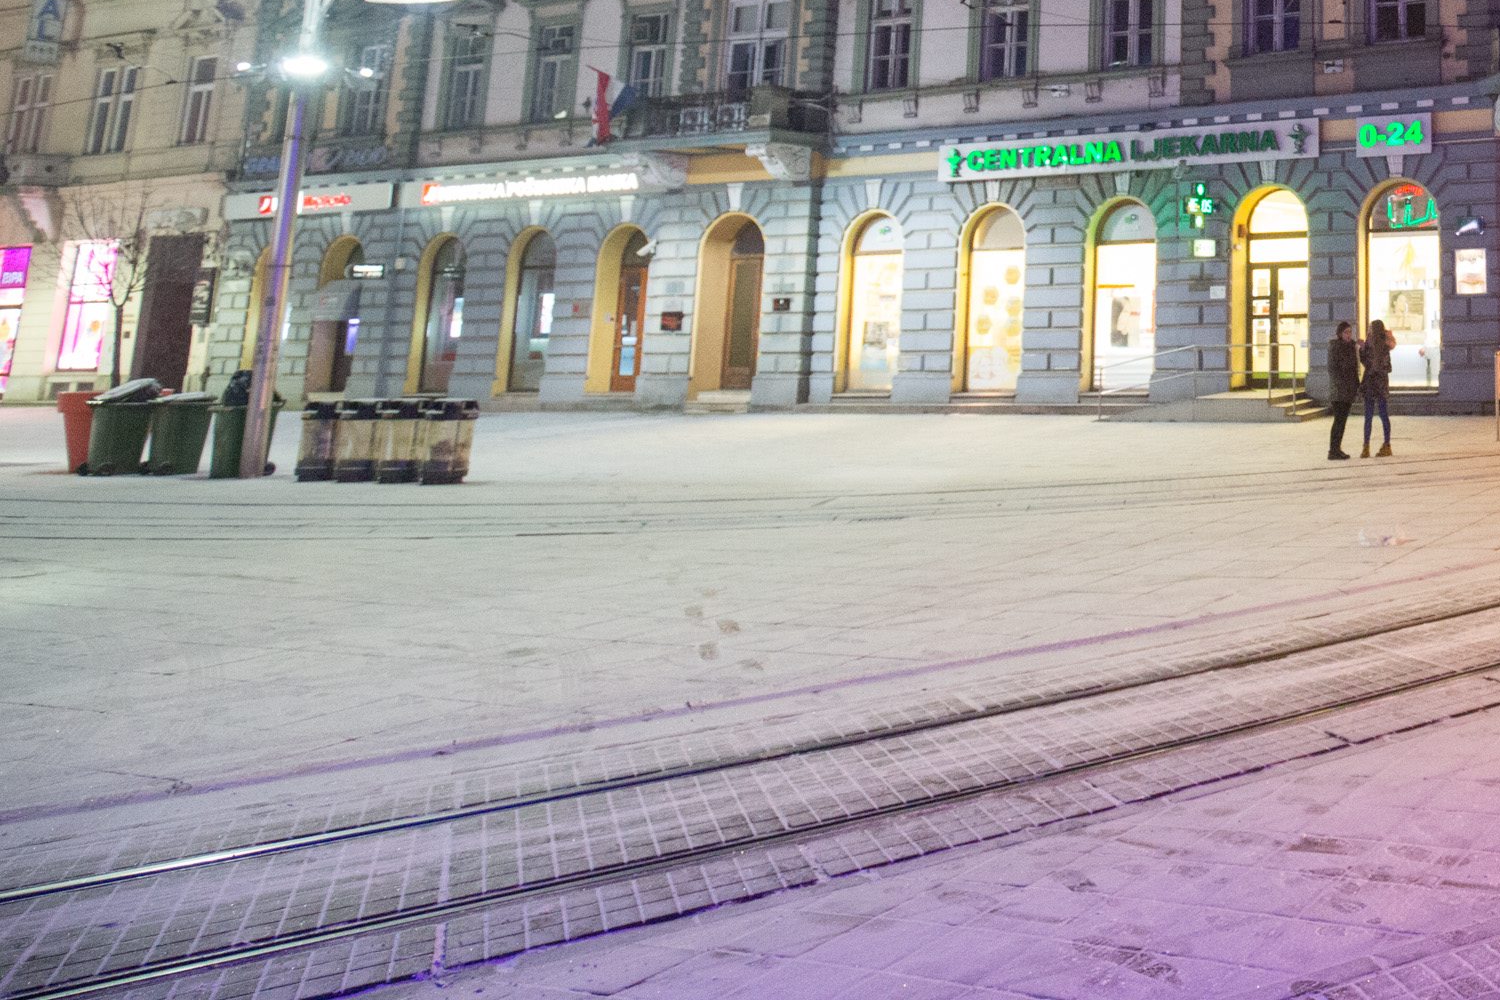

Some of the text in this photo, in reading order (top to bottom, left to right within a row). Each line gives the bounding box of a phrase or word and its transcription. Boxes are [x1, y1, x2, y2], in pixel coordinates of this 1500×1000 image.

[966, 130, 1280, 172] CENTRALNA LJEKARNA
[1359, 120, 1424, 149] 0-24
